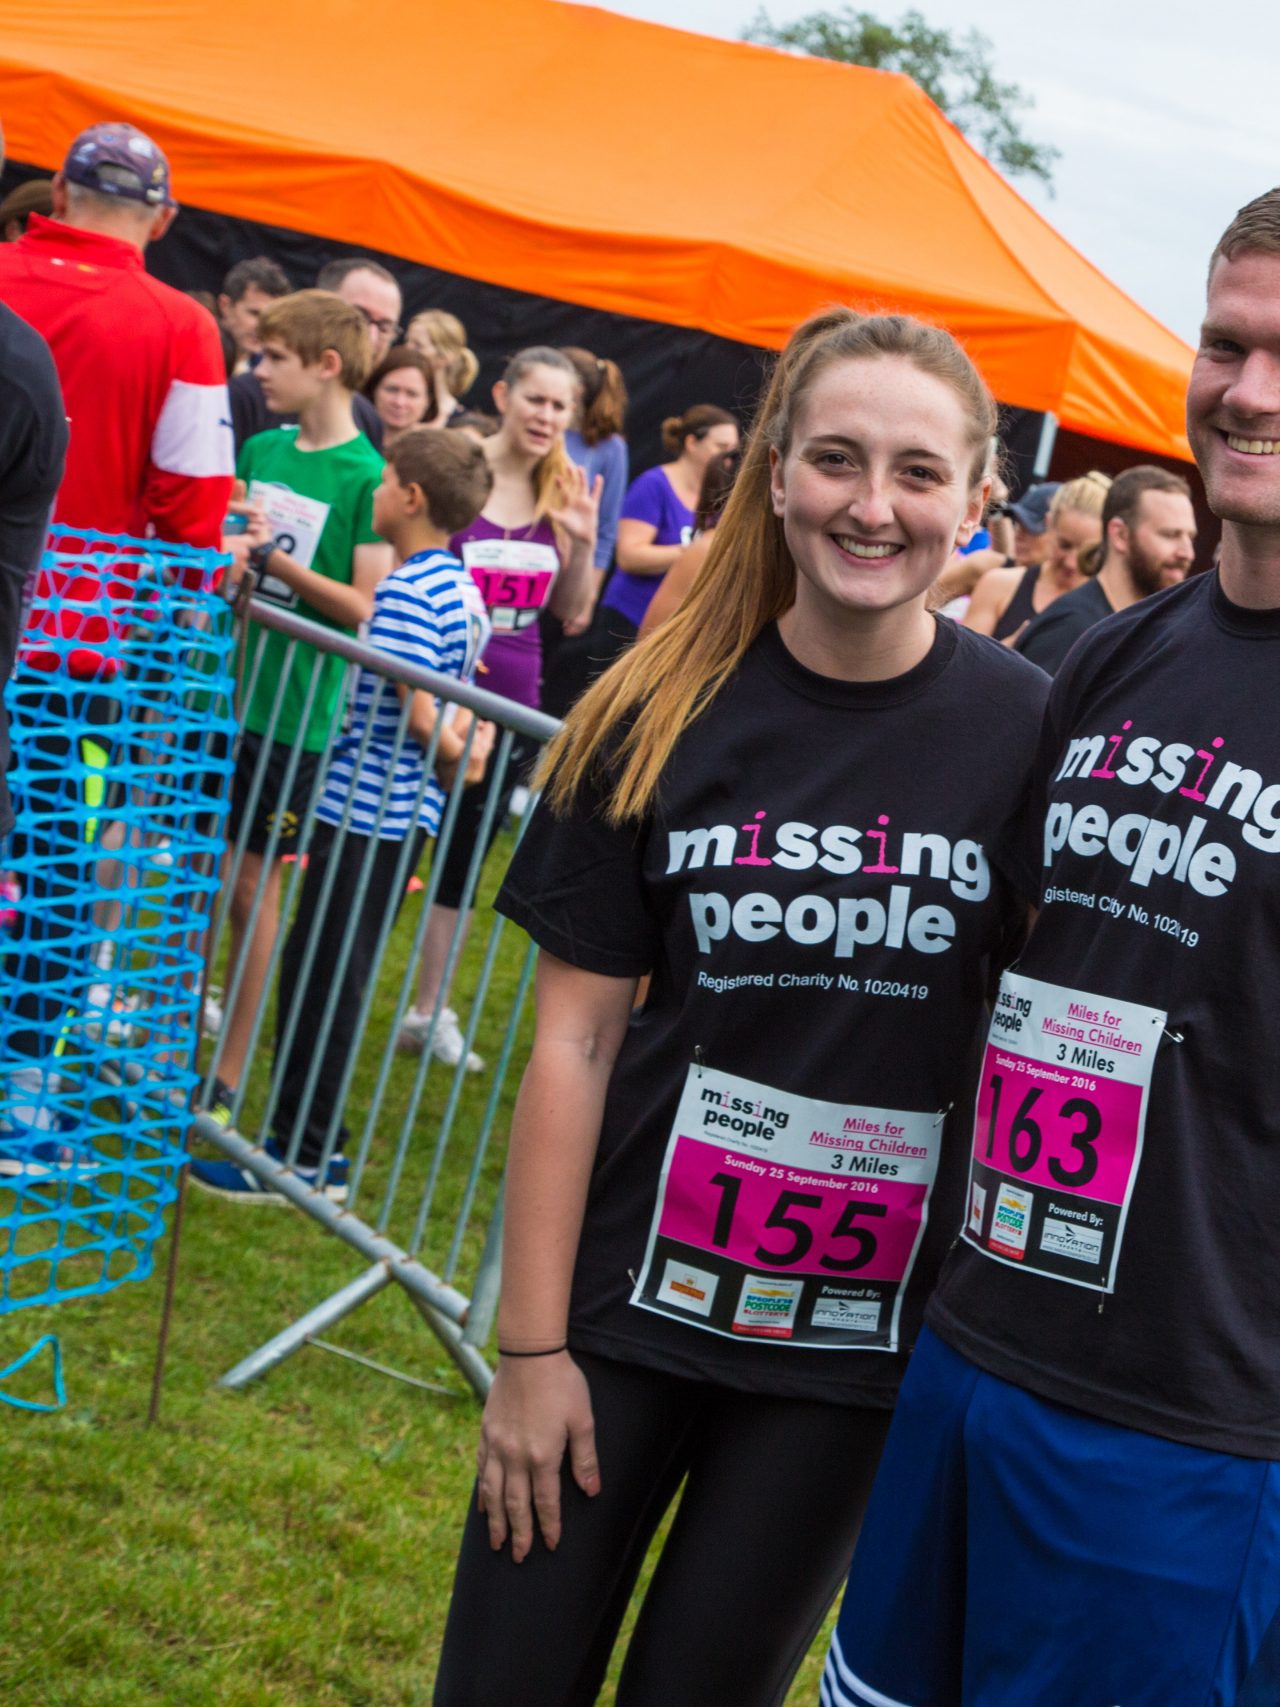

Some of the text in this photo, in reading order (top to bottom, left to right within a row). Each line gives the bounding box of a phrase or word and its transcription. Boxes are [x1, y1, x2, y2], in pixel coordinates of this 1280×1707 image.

[483, 575, 536, 604] 151
[666, 811, 991, 902] missing
[1043, 802, 1237, 897] people
[689, 885, 956, 958] people
[1044, 886, 1095, 908] gistered
[1127, 904, 1149, 925] No.
[698, 972, 928, 999] Registered Charity No. 1020419
[1068, 1003, 1122, 1028] Miles for
[1042, 1017, 1085, 1042] Missing
[1089, 1028, 1142, 1053] Children
[995, 1053, 1097, 1092] Sunday 25 September 2016
[1057, 1044, 1115, 1072] 3 Miles
[700, 1088, 790, 1129] missing
[703, 1109, 775, 1140] people
[843, 1117, 905, 1135] Miles for
[985, 1073, 1102, 1188] 163
[809, 1131, 928, 1156] Missing Children
[724, 1154, 879, 1193] Sunday 25 September 2016
[831, 1154, 899, 1176] 3 Miles
[708, 1171, 887, 1272] 155
[1048, 1202, 1104, 1227] Powered By:
[821, 1285, 881, 1299] Powered By:
